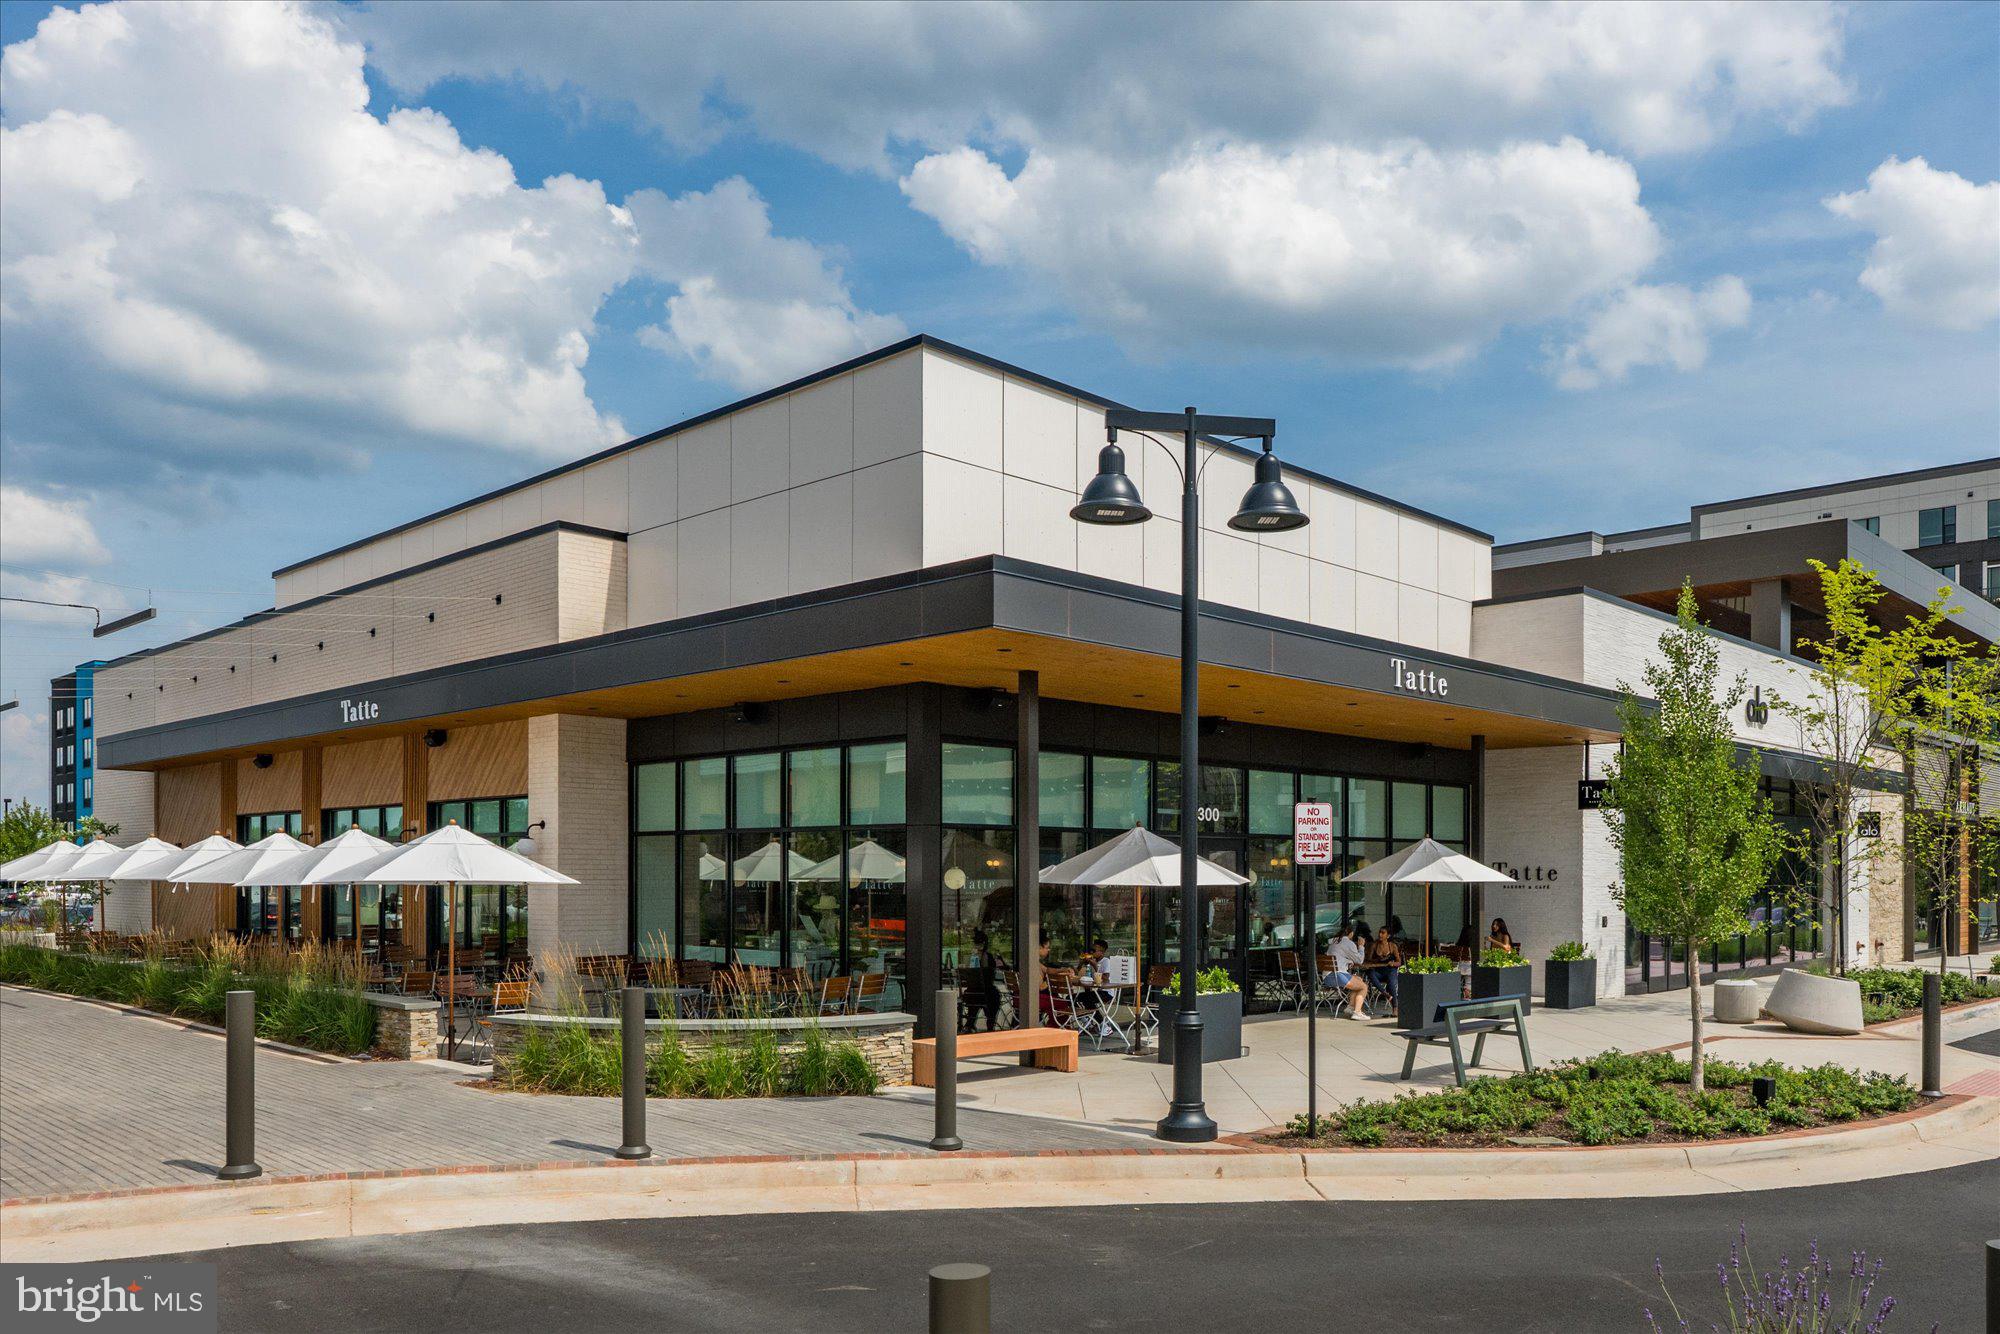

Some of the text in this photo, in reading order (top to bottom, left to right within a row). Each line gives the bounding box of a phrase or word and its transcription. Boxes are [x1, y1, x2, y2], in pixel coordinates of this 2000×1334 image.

[1390, 657, 1448, 696] Tatte
[340, 699, 379, 723] Tatte
[1746, 685, 1769, 725] alo
[1197, 807, 1220, 822] 300
[1307, 808, 1320, 816] NO
[1298, 817, 1329, 826] PARKING
[1298, 833, 1329, 841] STANDING
[1861, 825, 1879, 836] alo
[1298, 842, 1329, 852] FIRE LANE
[1492, 861, 1558, 882] Tatte
[1121, 959, 1129, 981] TATTE
